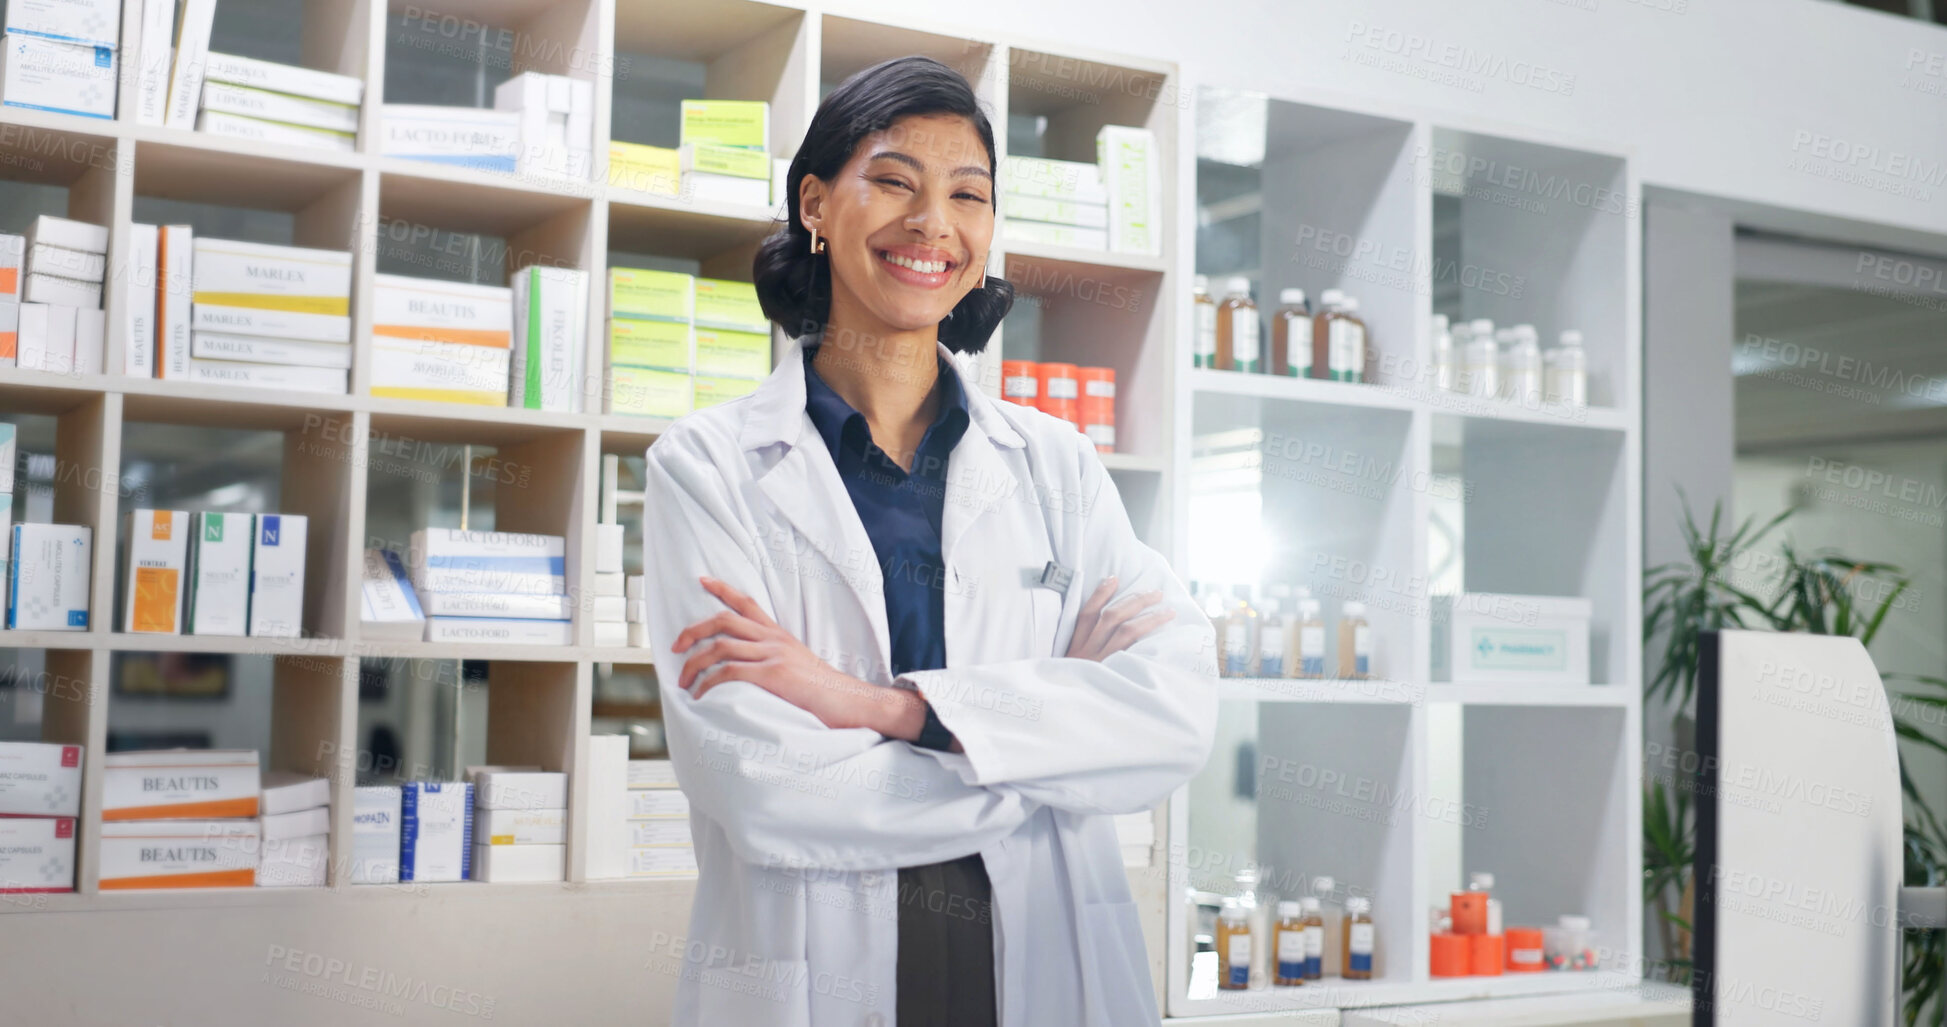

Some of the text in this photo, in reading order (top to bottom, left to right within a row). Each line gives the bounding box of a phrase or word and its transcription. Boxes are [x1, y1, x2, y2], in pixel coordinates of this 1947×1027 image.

[246, 265, 306, 282] MARLEX
[407, 299, 477, 319] BEAUTIS
[202, 312, 252, 327] MARLEX
[134, 317, 144, 367] BEAUTIS
[173, 323, 184, 372] BEAUTIS
[203, 340, 253, 354] MARLEX
[199, 367, 250, 381] MARLEX
[207, 525, 219, 538] N
[264, 529, 277, 543] N
[448, 529, 547, 548] LACTO-FORD
[441, 628, 510, 639] LACTO-FORD
[142, 776, 219, 792] BEAUTIS
[139, 847, 218, 863] BEAUTIS
